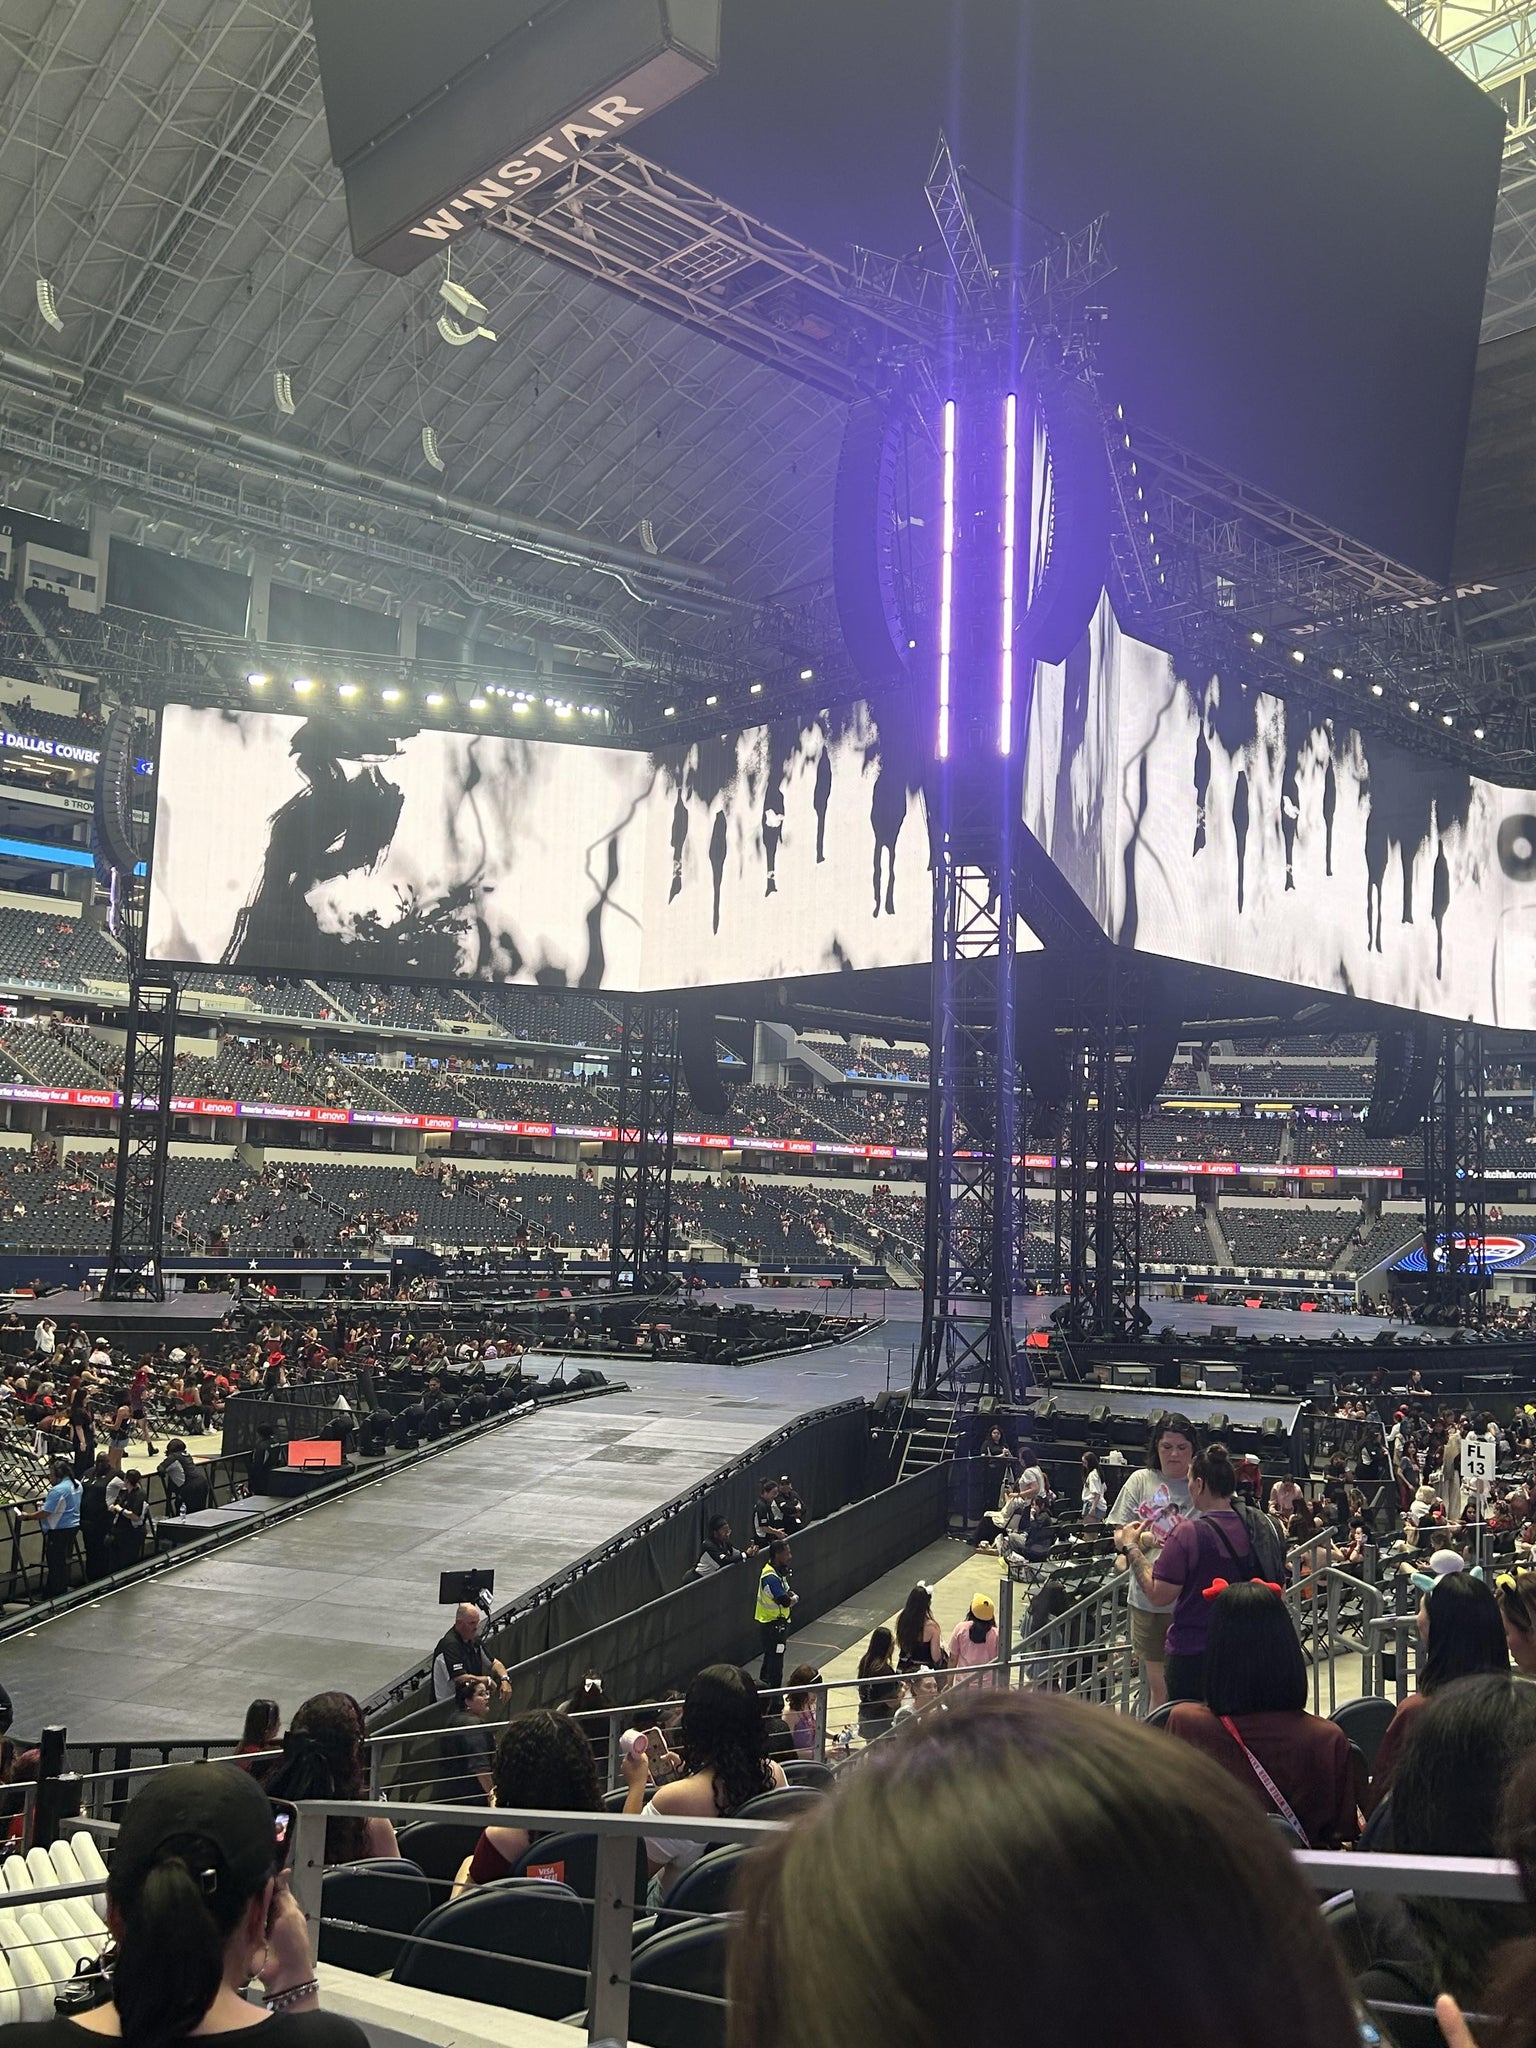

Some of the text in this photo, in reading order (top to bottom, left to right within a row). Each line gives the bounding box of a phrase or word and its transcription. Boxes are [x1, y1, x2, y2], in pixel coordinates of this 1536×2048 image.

[6, 734, 53, 754] DALLAS
[55, 745, 101, 764] COWBO
[77, 1092, 110, 1104] Lenovo
[202, 1102, 234, 1113] Lenovo
[318, 1110, 346, 1121] Lenovo
[425, 1118, 451, 1128] Lenovo
[524, 1124, 549, 1135] Lenovo
[706, 1137, 728, 1146] Lenovo
[789, 1142, 811, 1151] Lenovo
[870, 1147, 891, 1156] Lenovo
[1026, 1157, 1050, 1166] Lenovo
[1208, 1165, 1233, 1173] Lenovo
[1306, 1168, 1331, 1176] Lenovo
[1467, 1444, 1486, 1459] FL
[1467, 1461, 1485, 1475] 13
[538, 1867, 555, 1875] VISA
